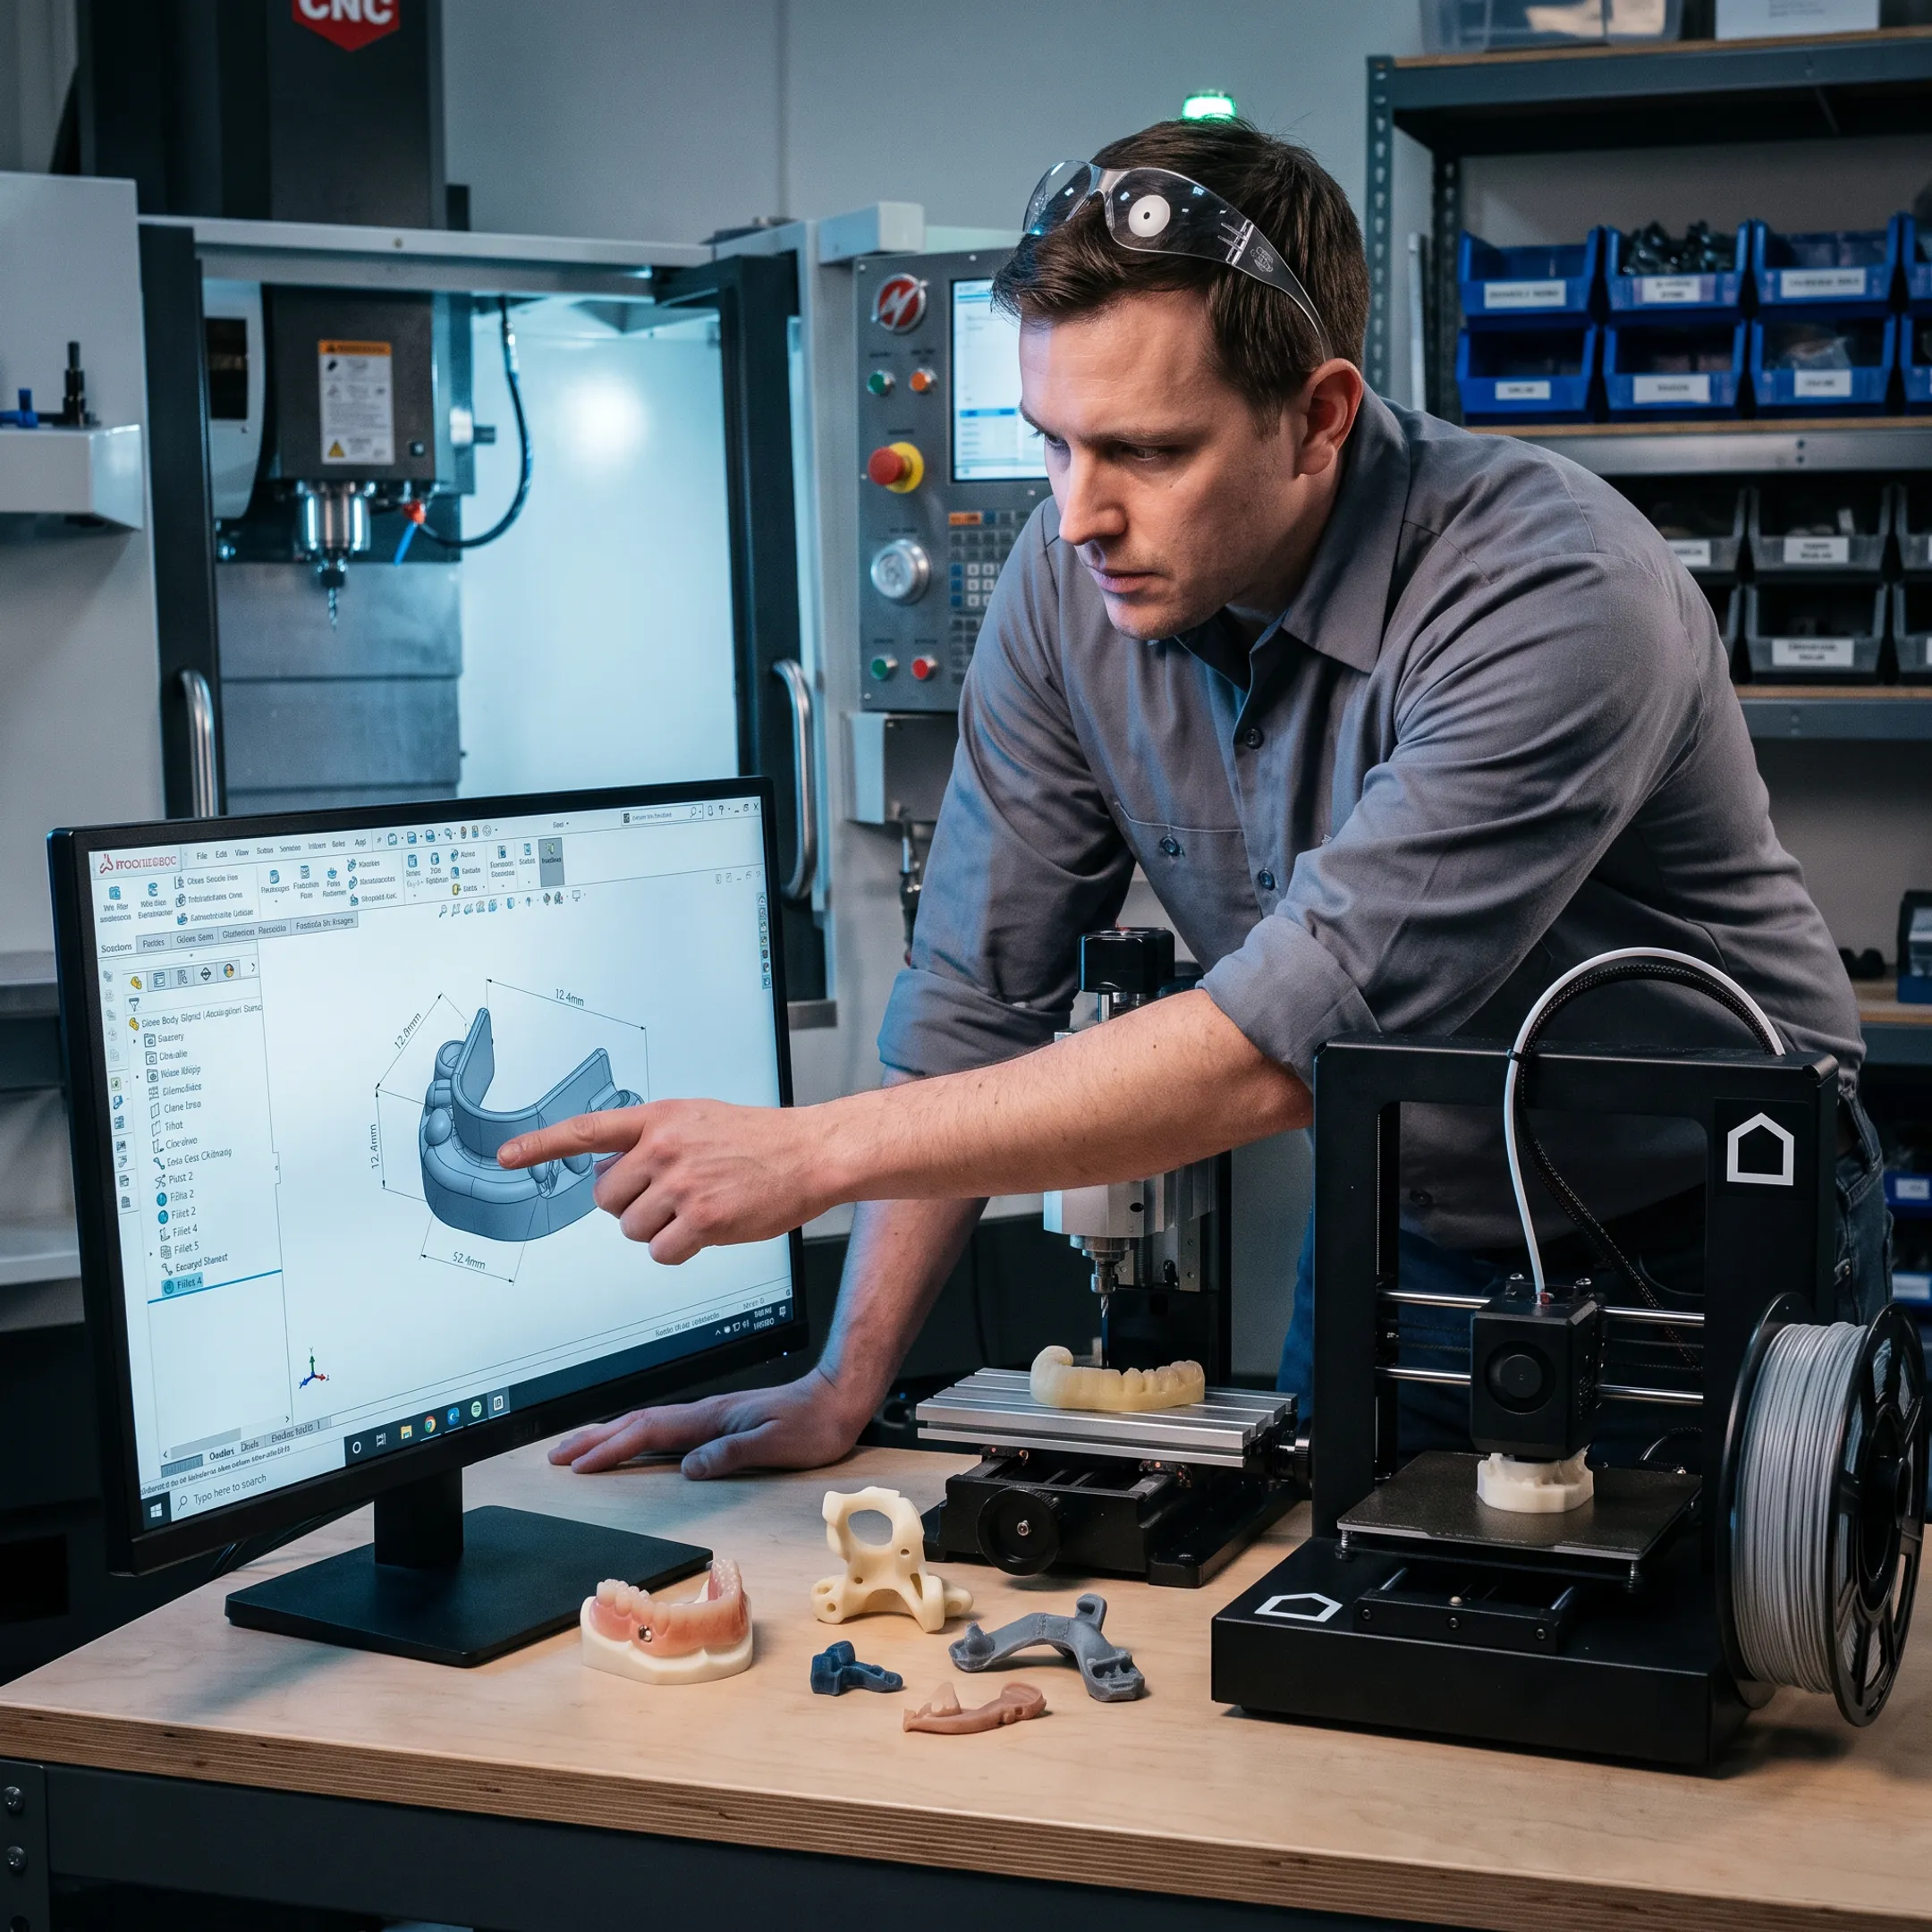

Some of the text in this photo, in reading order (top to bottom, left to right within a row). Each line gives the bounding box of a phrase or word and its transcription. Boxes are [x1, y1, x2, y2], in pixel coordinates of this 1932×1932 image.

[299, 0, 393, 25] CNC
[162, 1016, 179, 1025] Body
[188, 1171, 193, 1181] 2
[189, 1189, 194, 1199] 2
[191, 1206, 196, 1216] 2
[192, 1223, 198, 1233] 4
[194, 1241, 199, 1250] 5
[214, 1486, 231, 1497] here
[232, 1483, 241, 1492] to
